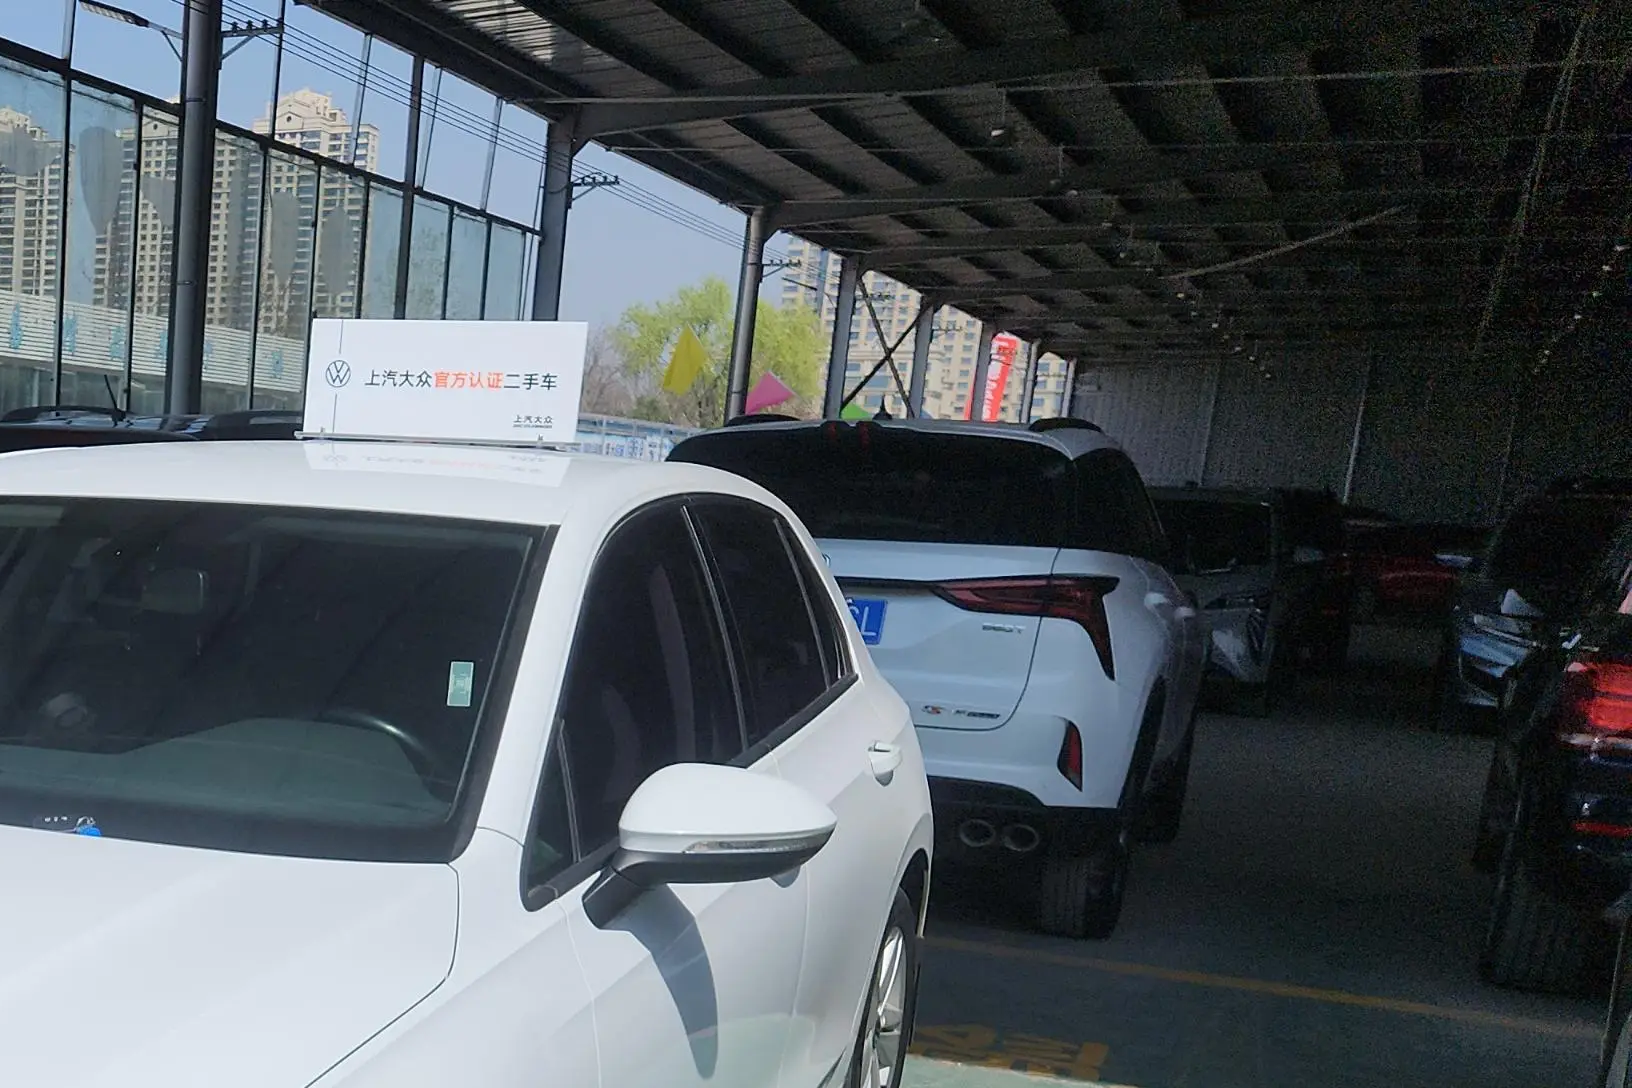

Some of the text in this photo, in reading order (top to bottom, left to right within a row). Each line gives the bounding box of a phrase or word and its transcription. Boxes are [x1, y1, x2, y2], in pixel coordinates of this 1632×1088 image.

[364, 369, 557, 391] 上汽大众官方认证二手车
[513, 415, 553, 424] 上汽大众
